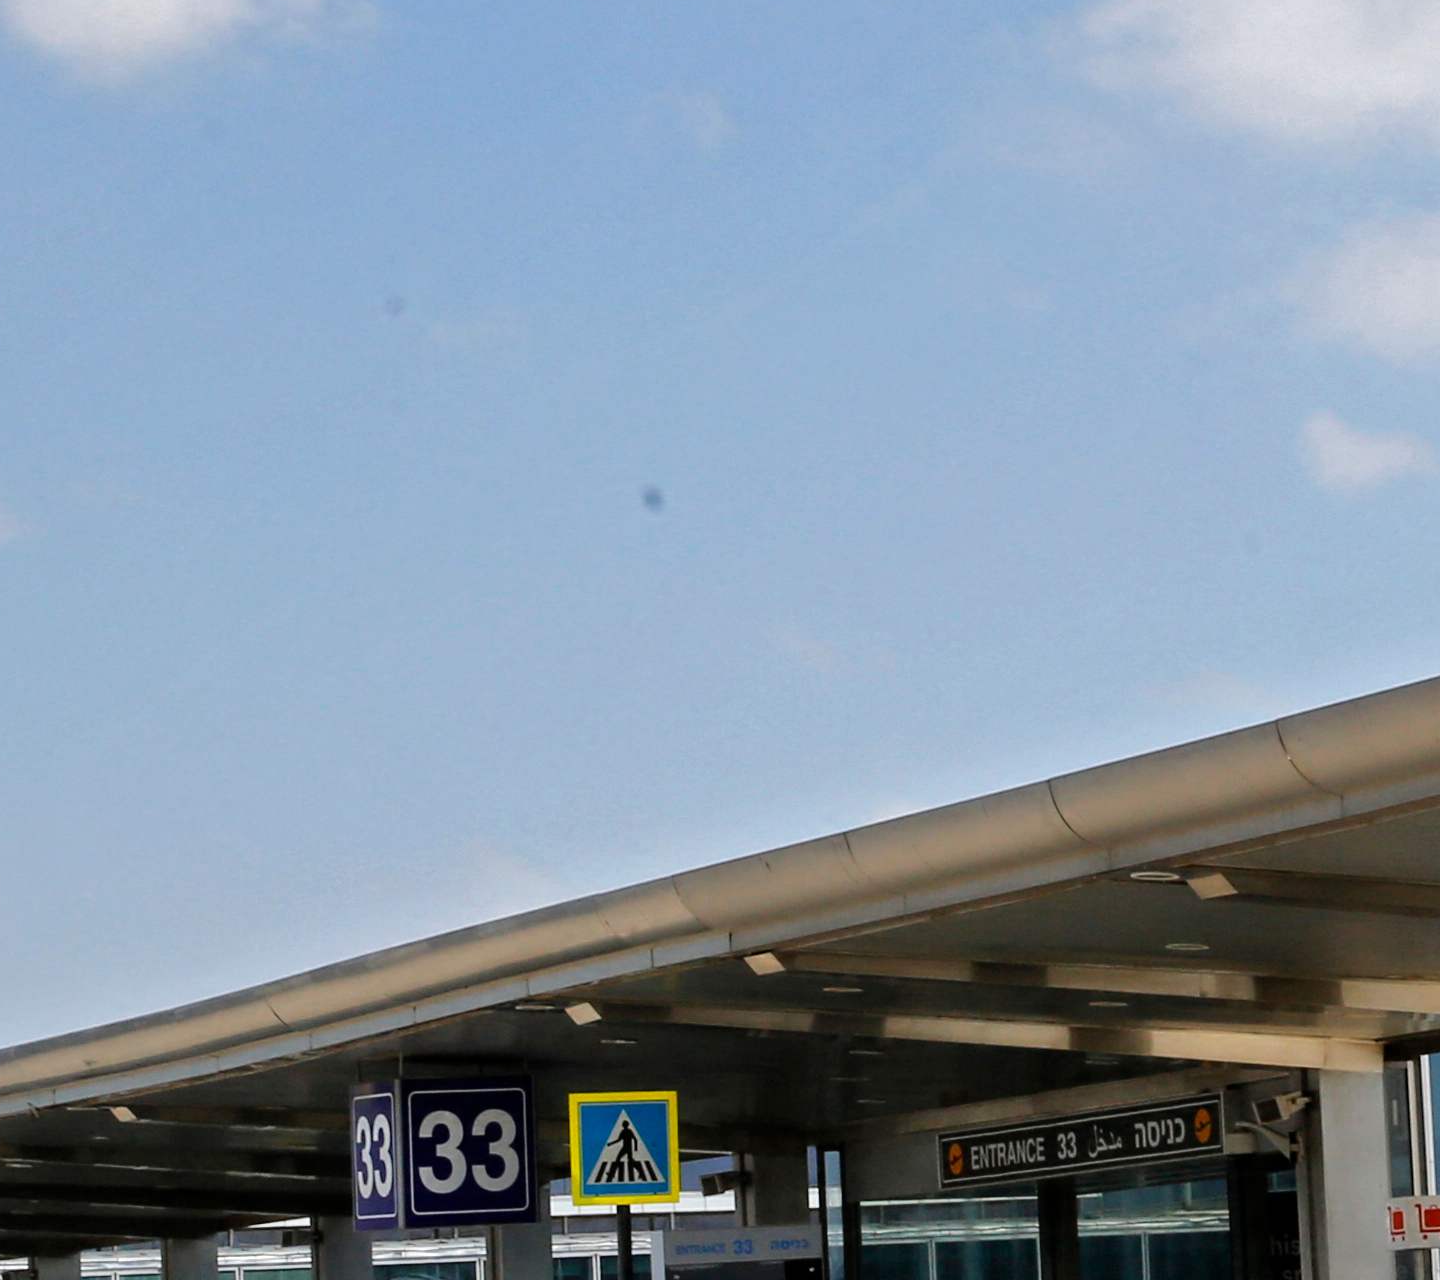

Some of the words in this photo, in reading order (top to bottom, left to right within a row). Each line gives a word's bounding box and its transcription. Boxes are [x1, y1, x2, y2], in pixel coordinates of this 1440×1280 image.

[418, 1108, 520, 1194] 33
[970, 1137, 1046, 1170] ENTRANCE
[1057, 1131, 1077, 1159] 33
[1088, 1125, 1123, 1158] مدخل
[1134, 1118, 1186, 1148] כניסה
[357, 1114, 393, 1199] 33
[675, 1243, 726, 1256] ENTRANCE
[733, 1239, 753, 1255] 33
